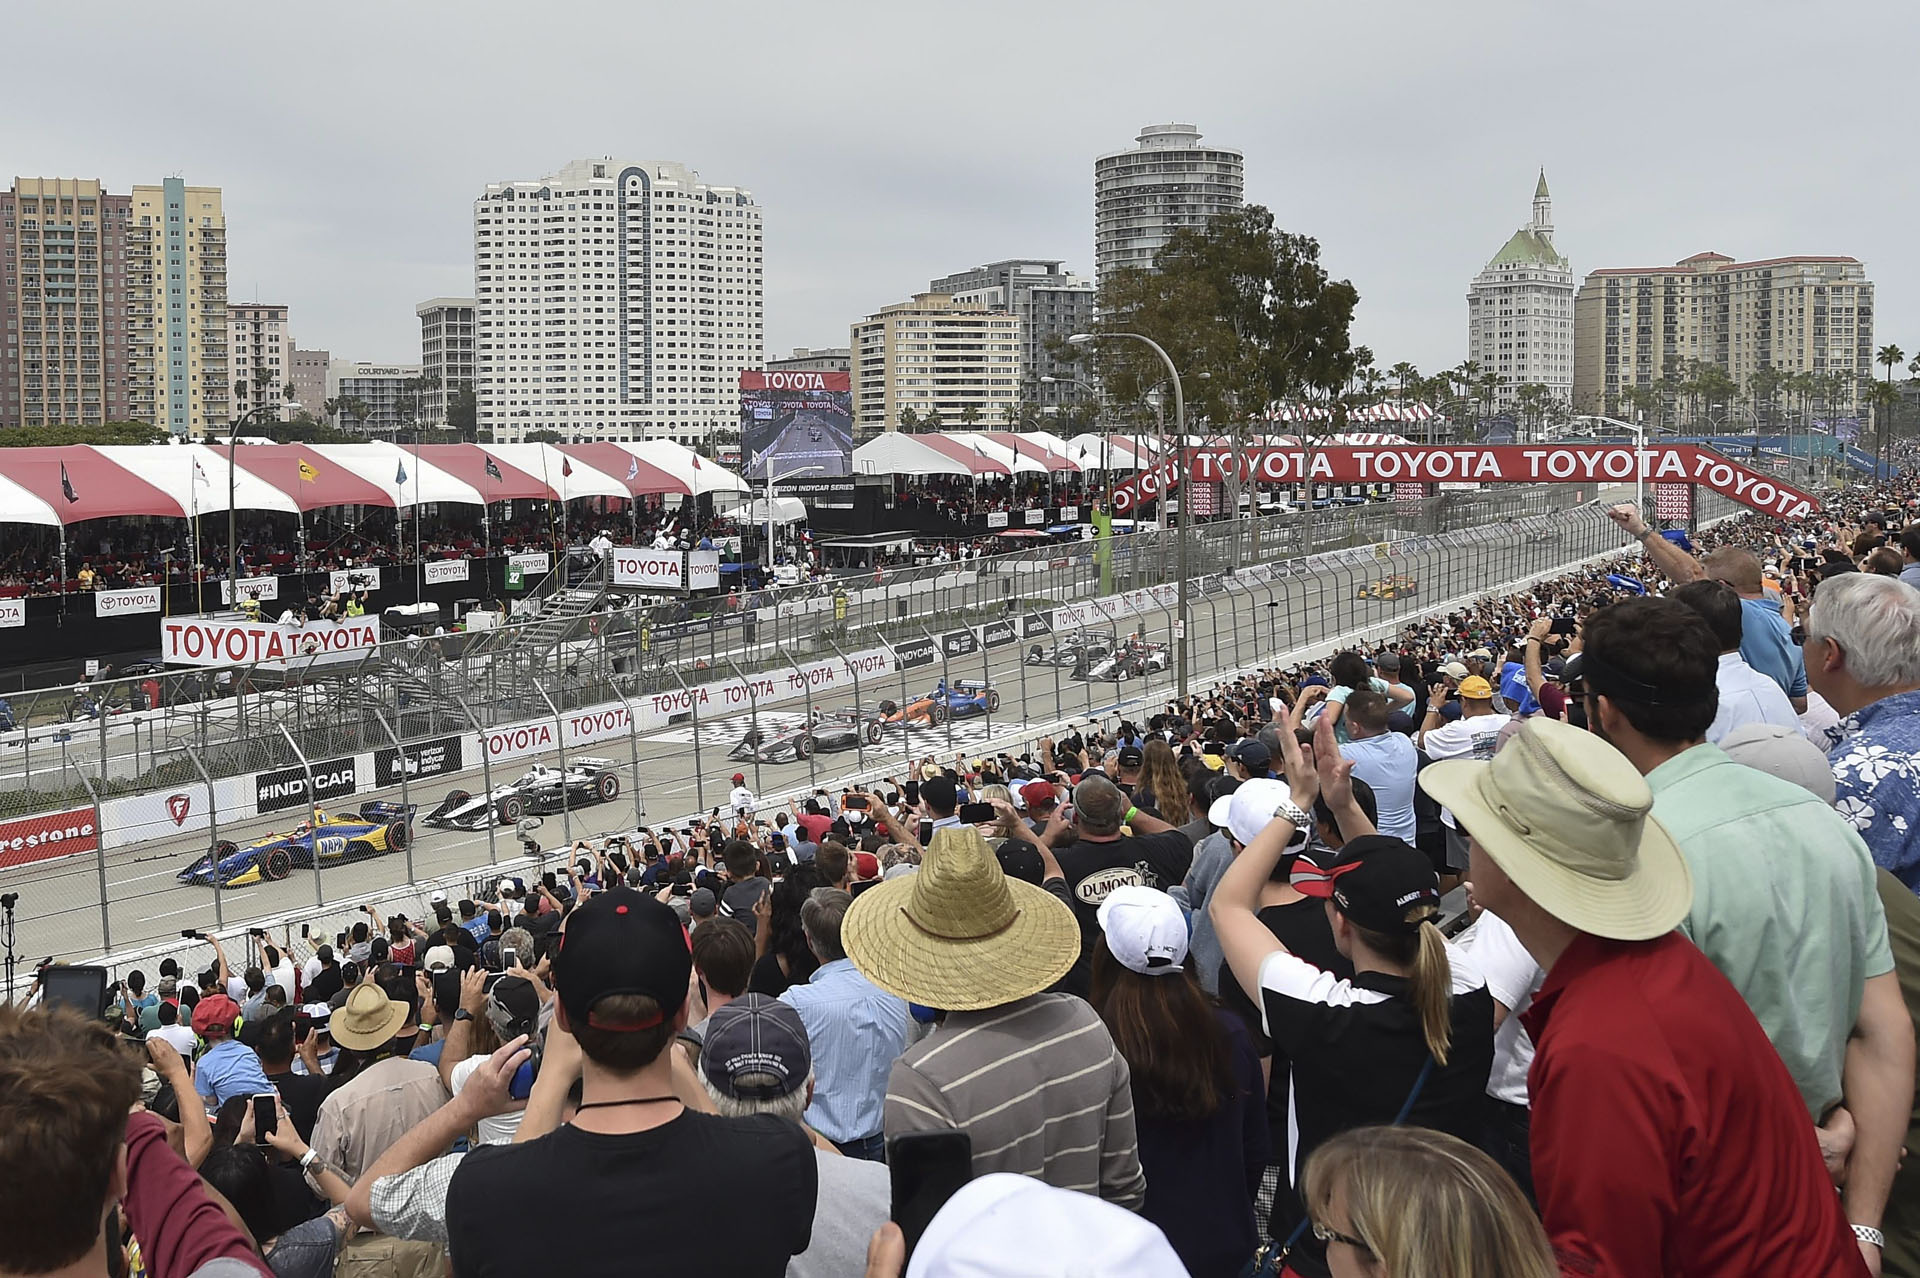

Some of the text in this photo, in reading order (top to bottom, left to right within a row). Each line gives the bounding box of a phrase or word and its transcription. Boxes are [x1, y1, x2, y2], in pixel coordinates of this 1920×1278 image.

[358, 367, 399, 375] COURTYARD
[762, 373, 825, 389] TOYOTA
[806, 401, 832, 409] TOYOTA
[1197, 451, 1333, 478] TOYOTA
[1352, 450, 1502, 478] TOYOTA
[1523, 450, 1687, 478] TOYOTA
[831, 483, 854, 491] SERIES
[1694, 454, 1811, 520] TOYOTA
[439, 566, 466, 576] TOYOTA
[522, 559, 546, 568] TOYOTA
[617, 559, 680, 577] TOYOTA
[690, 564, 718, 575] TOYOTA
[509, 572, 520, 584] 32
[239, 583, 273, 593] TOYOTA
[117, 595, 156, 607] TOYOTA
[1091, 602, 1117, 618] TOYOTA
[1058, 608, 1086, 626] TOYOTA
[166, 625, 286, 664] TOYOTA
[287, 626, 377, 655] TOYOTA
[897, 645, 934, 663] INDYCAR
[844, 654, 886, 677] TOYOTA
[788, 666, 834, 690] TOYOTA
[652, 687, 710, 714] TOYOTA
[724, 679, 775, 704] TOYOTA
[571, 709, 632, 737] TOYOTA
[259, 769, 354, 801] #INDYCAR
[320, 838, 344, 854] NAPA
[1083, 875, 1138, 898] DUMONT
[1396, 890, 1421, 907] ALBERT
